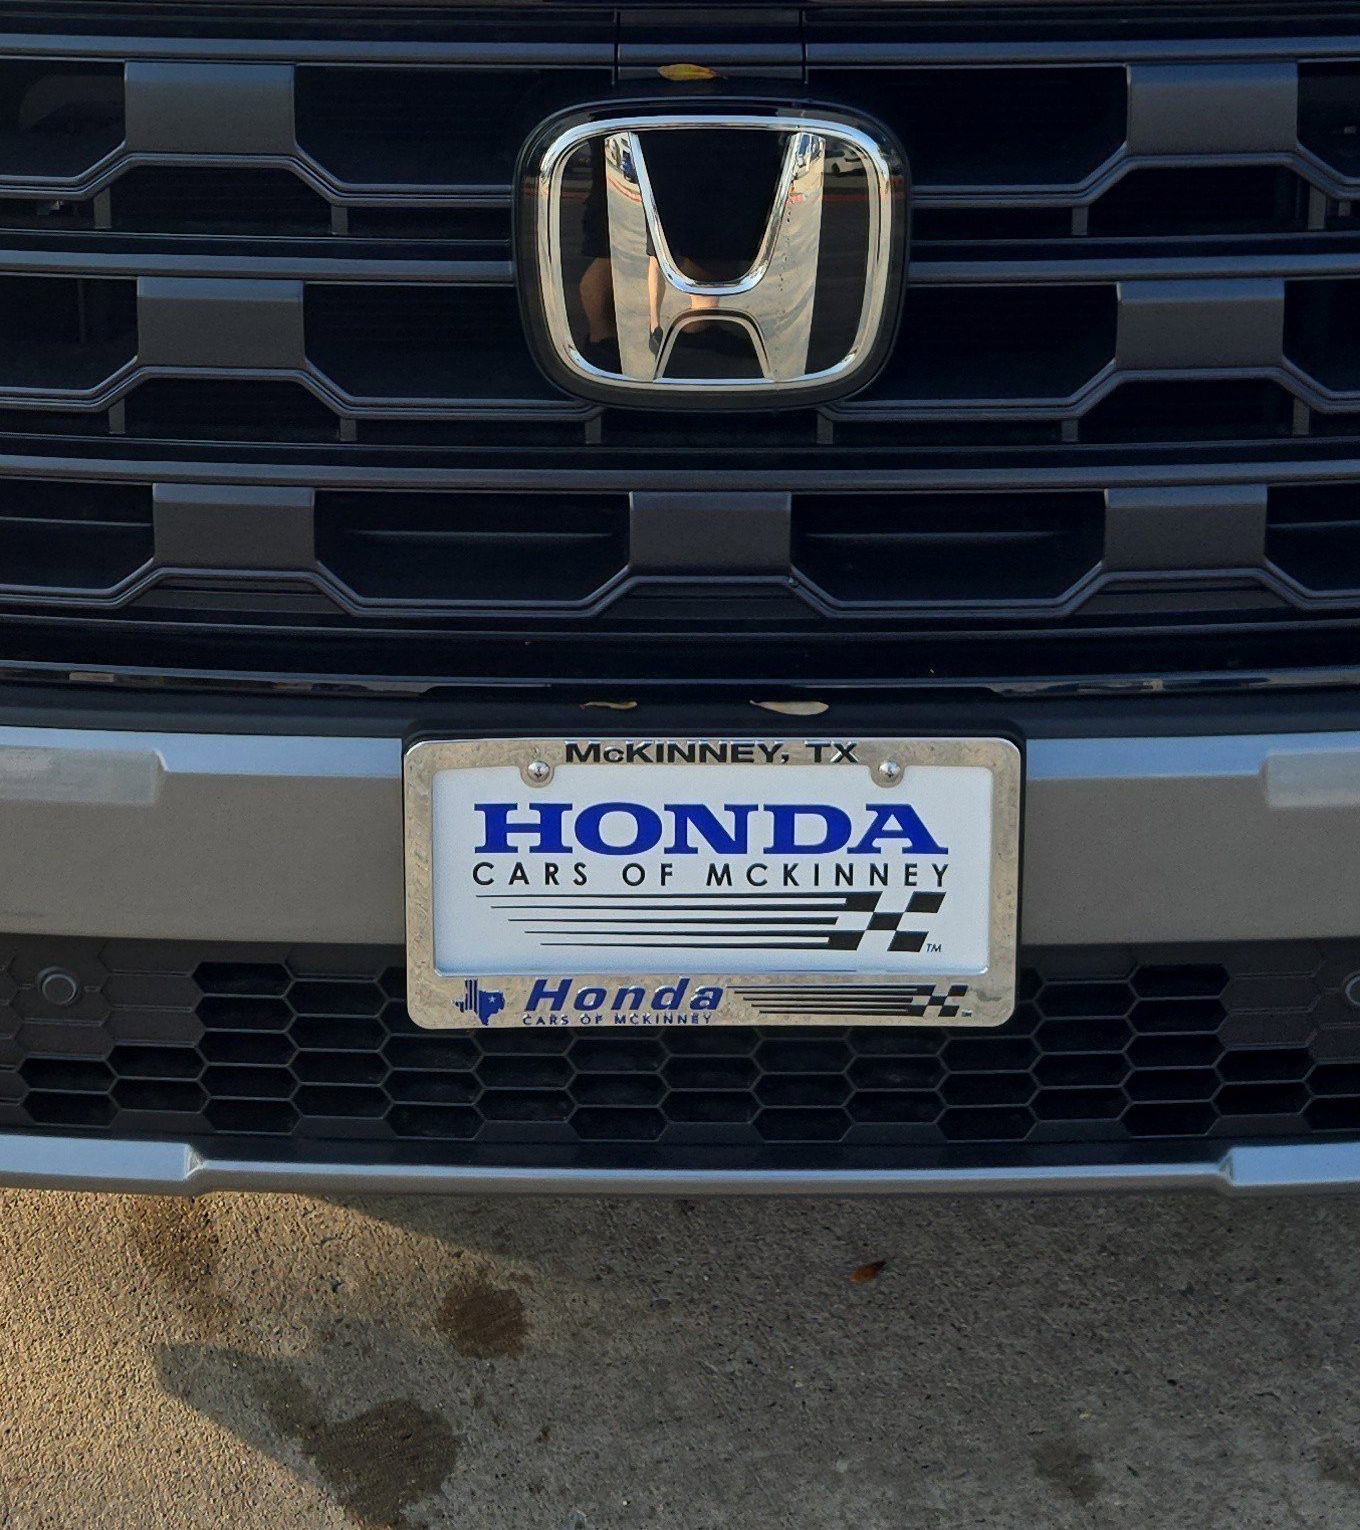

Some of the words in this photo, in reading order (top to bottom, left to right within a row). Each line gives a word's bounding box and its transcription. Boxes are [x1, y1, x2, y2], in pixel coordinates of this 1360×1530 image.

[565, 740, 789, 764] McKINNEY,
[804, 740, 859, 764] TX
[474, 802, 949, 856] HONDA
[472, 861, 588, 886] CARS
[621, 862, 673, 887] OF
[706, 862, 949, 887] MCKINNEY
[523, 976, 724, 1012] Honda
[522, 1013, 570, 1026] CARS
[580, 1013, 604, 1025] OF
[614, 1013, 713, 1025] MCKINNEY
